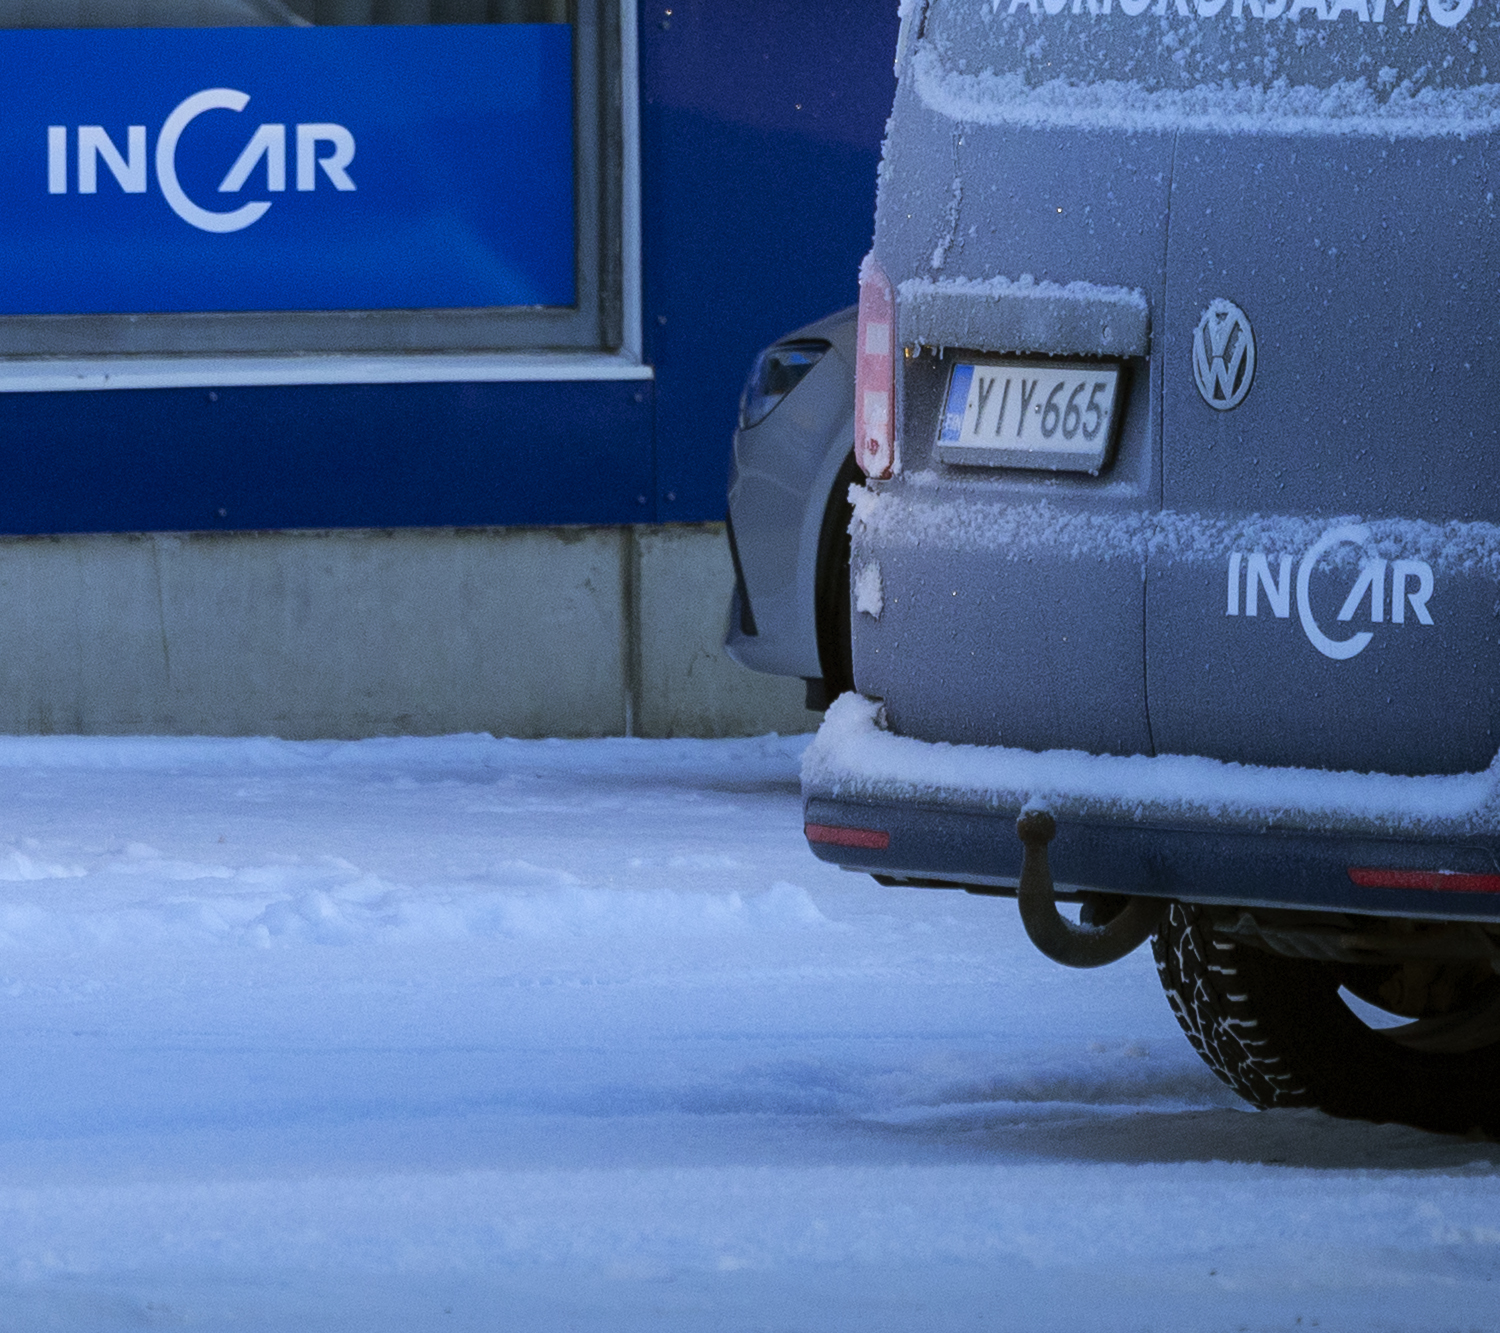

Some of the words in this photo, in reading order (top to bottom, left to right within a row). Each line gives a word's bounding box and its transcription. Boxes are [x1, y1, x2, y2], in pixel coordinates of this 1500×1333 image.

[47, 87, 357, 234] INCAR
[972, 376, 1108, 442] YIY-665
[1225, 521, 1435, 661] INCAR
